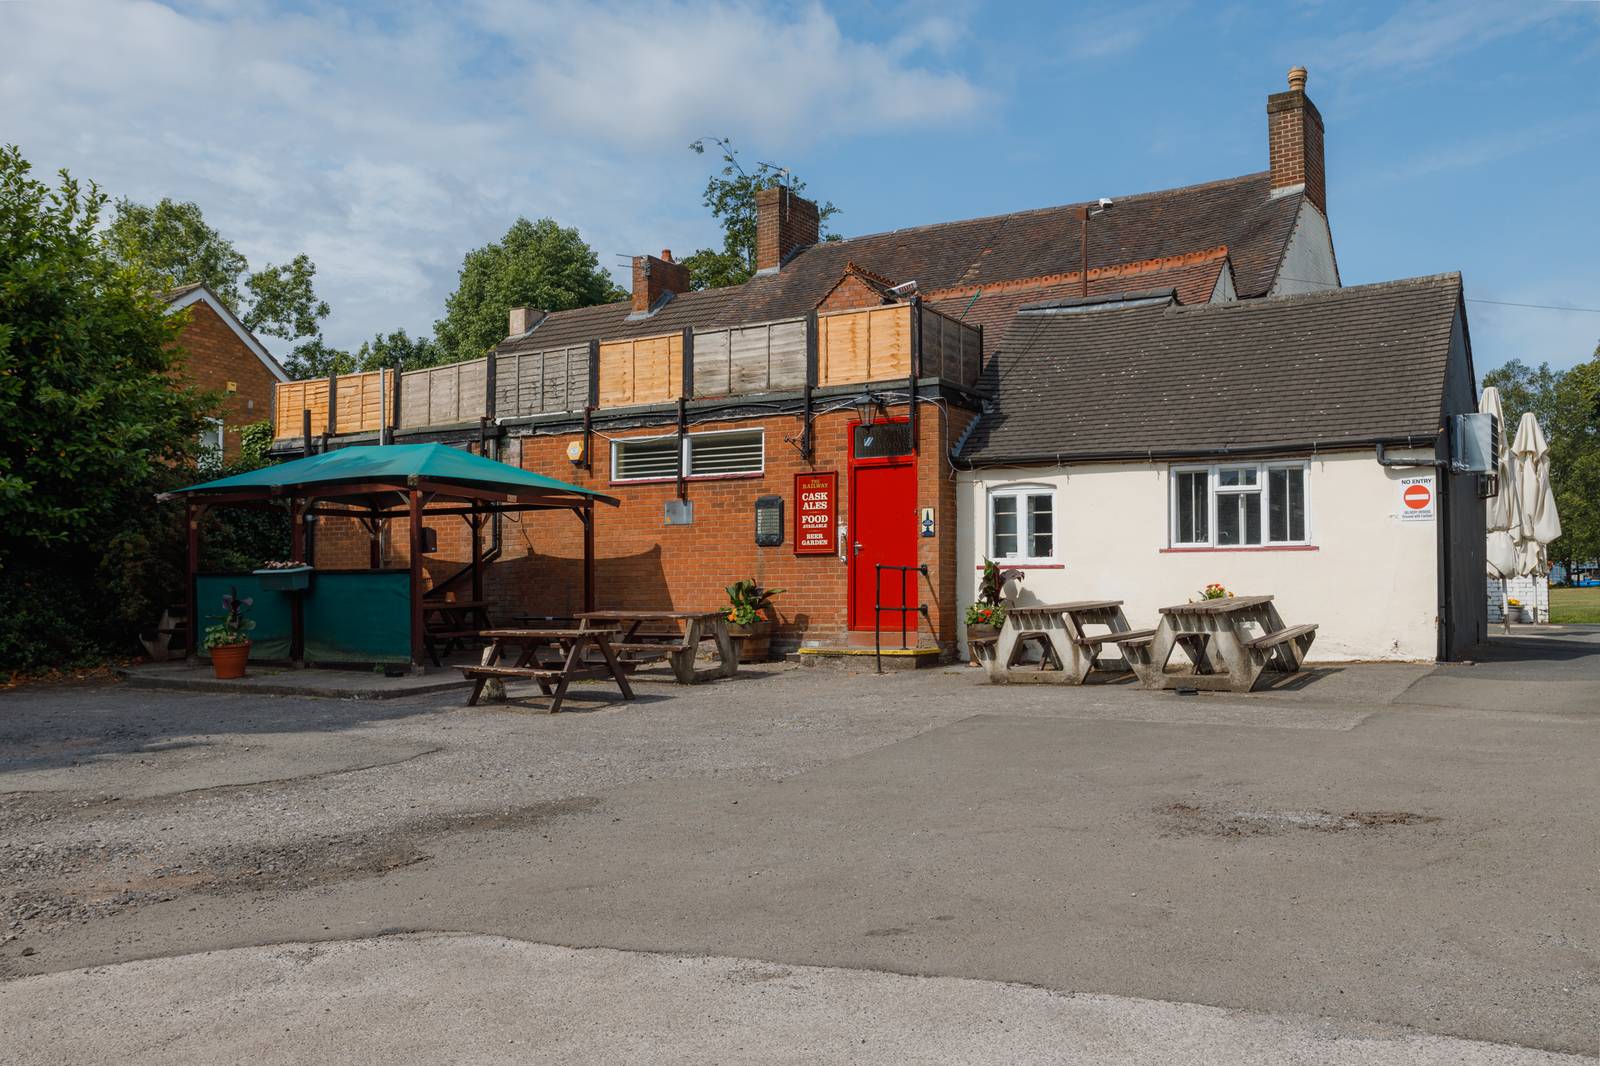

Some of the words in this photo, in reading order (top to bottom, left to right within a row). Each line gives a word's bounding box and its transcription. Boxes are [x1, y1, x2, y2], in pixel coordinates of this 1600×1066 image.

[802, 492, 828, 501] CASK
[802, 502, 828, 510] ALES
[802, 515, 828, 523] FOOD
